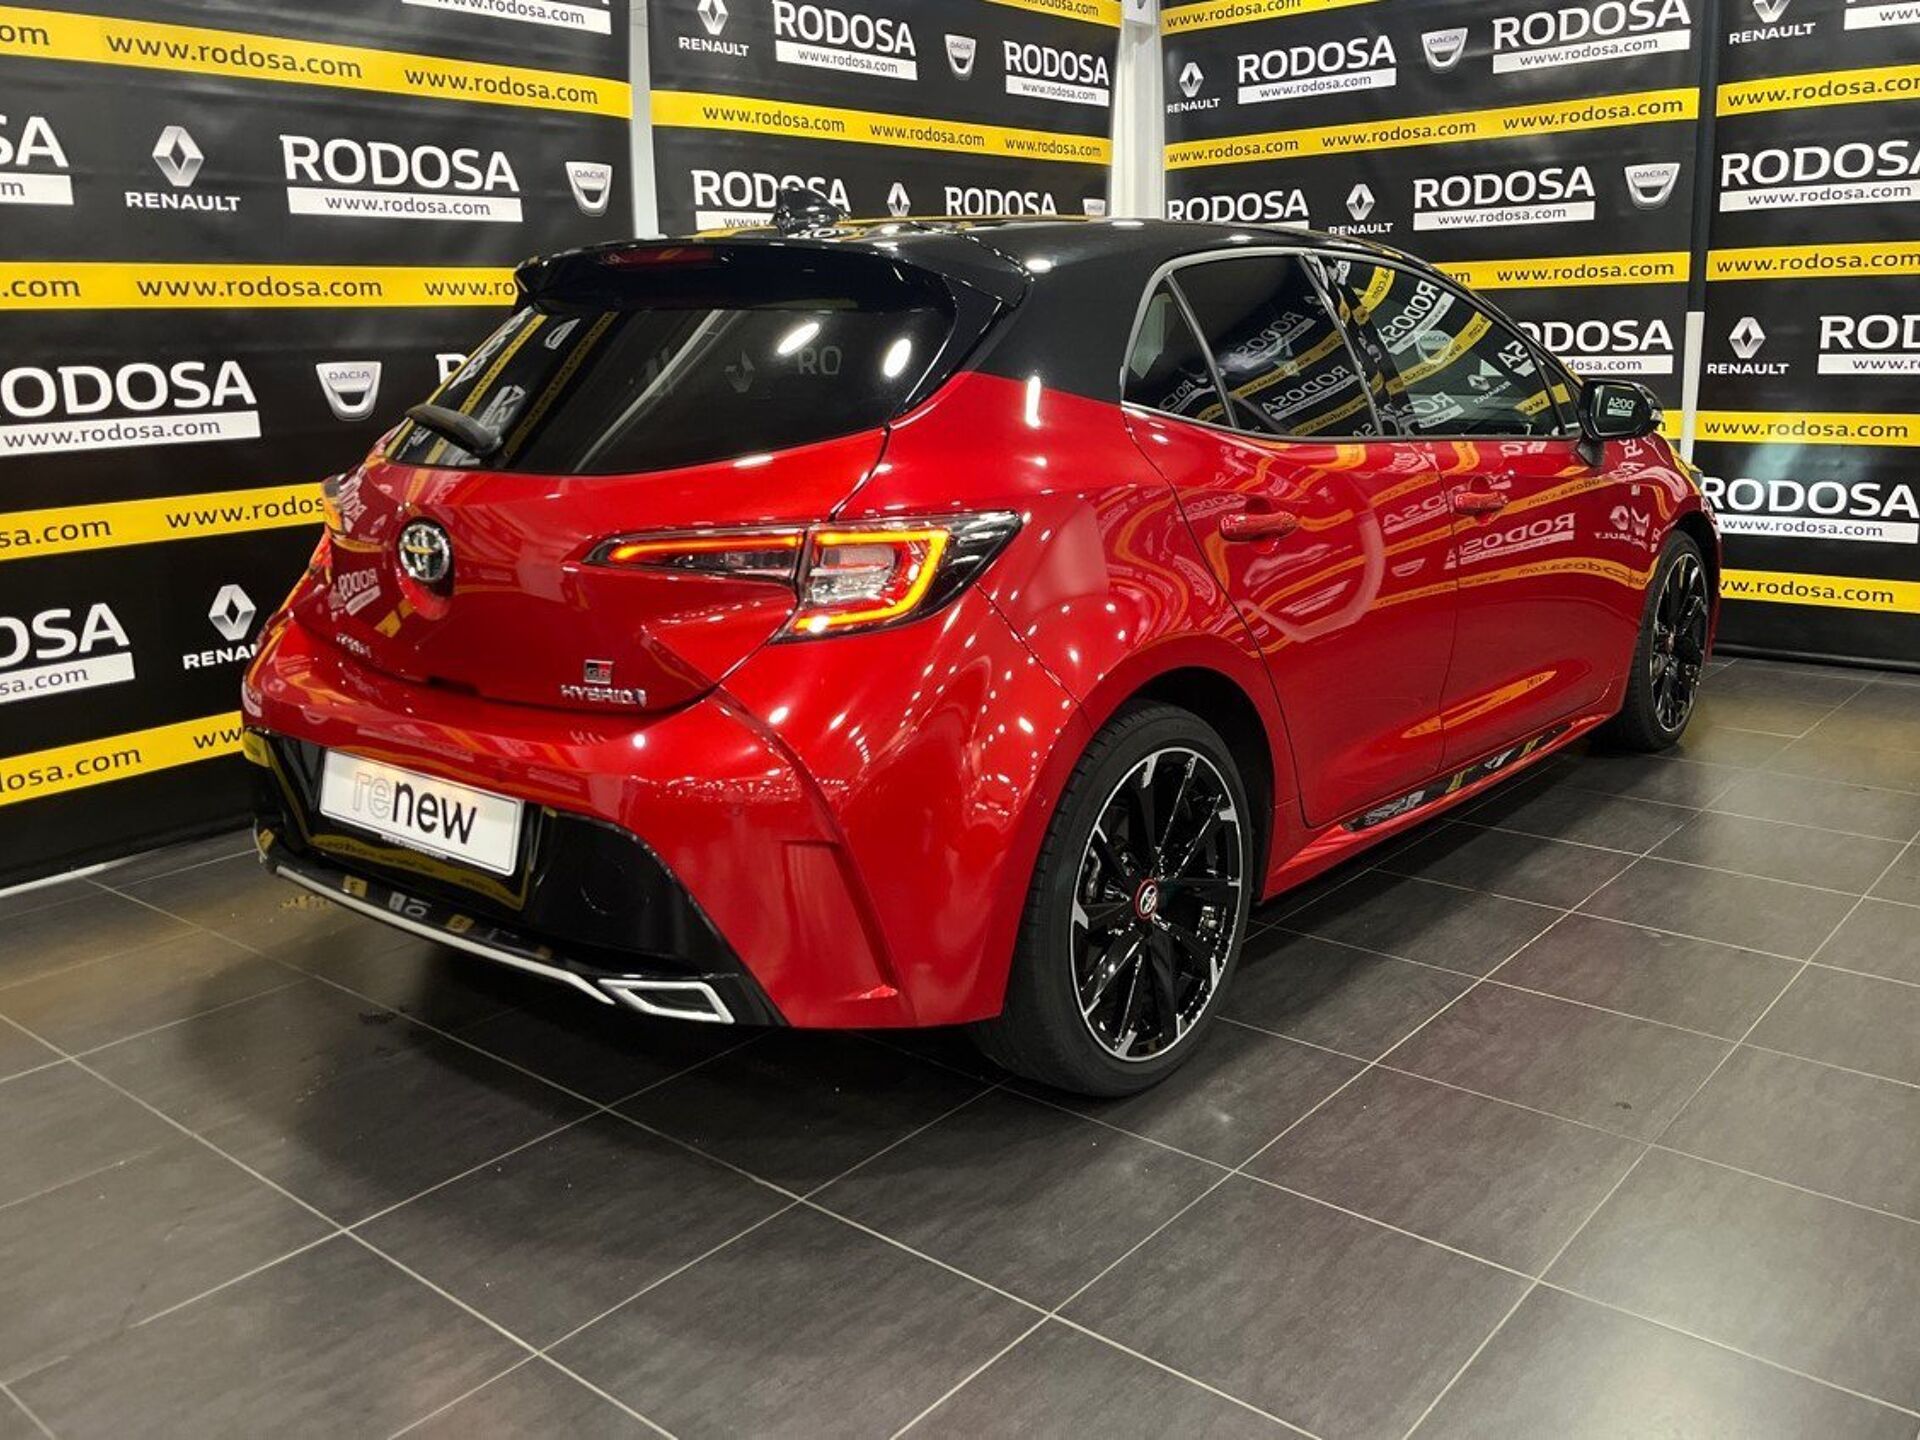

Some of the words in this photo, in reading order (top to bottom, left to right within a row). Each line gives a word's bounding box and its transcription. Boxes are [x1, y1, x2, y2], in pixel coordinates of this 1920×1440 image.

[772, 0, 916, 56] RODOSA
[1492, 0, 1692, 50] RODOSA
[1728, 22, 1816, 45] RENAULT
[106, 35, 362, 78] www.rodosa.com
[678, 36, 749, 57] RENAULT
[1519, 37, 1658, 66] www.rodosa.com
[797, 48, 898, 75] www.rodosa.com
[1003, 40, 1109, 86] RODOSA
[1237, 35, 1397, 84] RODOSA
[404, 69, 598, 104] www.rodosa.com
[1021, 82, 1097, 101] www.rodosa.com
[1260, 75, 1371, 99] www.rodosa.com
[1727, 77, 1920, 107] www.rodosa.co
[1167, 98, 1220, 114] RENAULT
[1502, 97, 1683, 131] www.rodosa.com
[702, 105, 845, 133] www.rodosa.com
[869, 123, 985, 147] www.rodosa.com
[1321, 121, 1476, 148] www.rodosa.com
[1005, 138, 1102, 158] www.rodosa.com
[1168, 138, 1299, 164] www.rodosa.com
[279, 134, 520, 193] RODOSA
[1633, 169, 1670, 179] DACIA
[1413, 166, 1596, 209] RODOSA
[1748, 185, 1911, 206] www.rodosa.com
[125, 191, 241, 212] RENAULT
[325, 195, 491, 217] www.rodosa.com
[945, 186, 1058, 216] RODOSA
[1168, 189, 1310, 222] RODOSA
[1328, 222, 1394, 236] RENAULT
[1438, 207, 1566, 226] www.rodosa.com
[1497, 262, 1674, 283] www.rodosa.com
[1717, 252, 1920, 273] www.rodosa.com
[137, 276, 383, 298] www.rodosa.com
[328, 370, 371, 381] DACIA
[1707, 362, 1790, 375] RENAULT
[4, 420, 221, 448] www.rodosa.com
[1704, 420, 1909, 438] www.rodosa.com
[1701, 476, 1919, 519] RODOSA
[1722, 518, 1884, 537] www.rodosa.com
[560, 684, 637, 705] HYBRID
[0, 747, 142, 794] osa.com
[352, 771, 477, 845] renew
